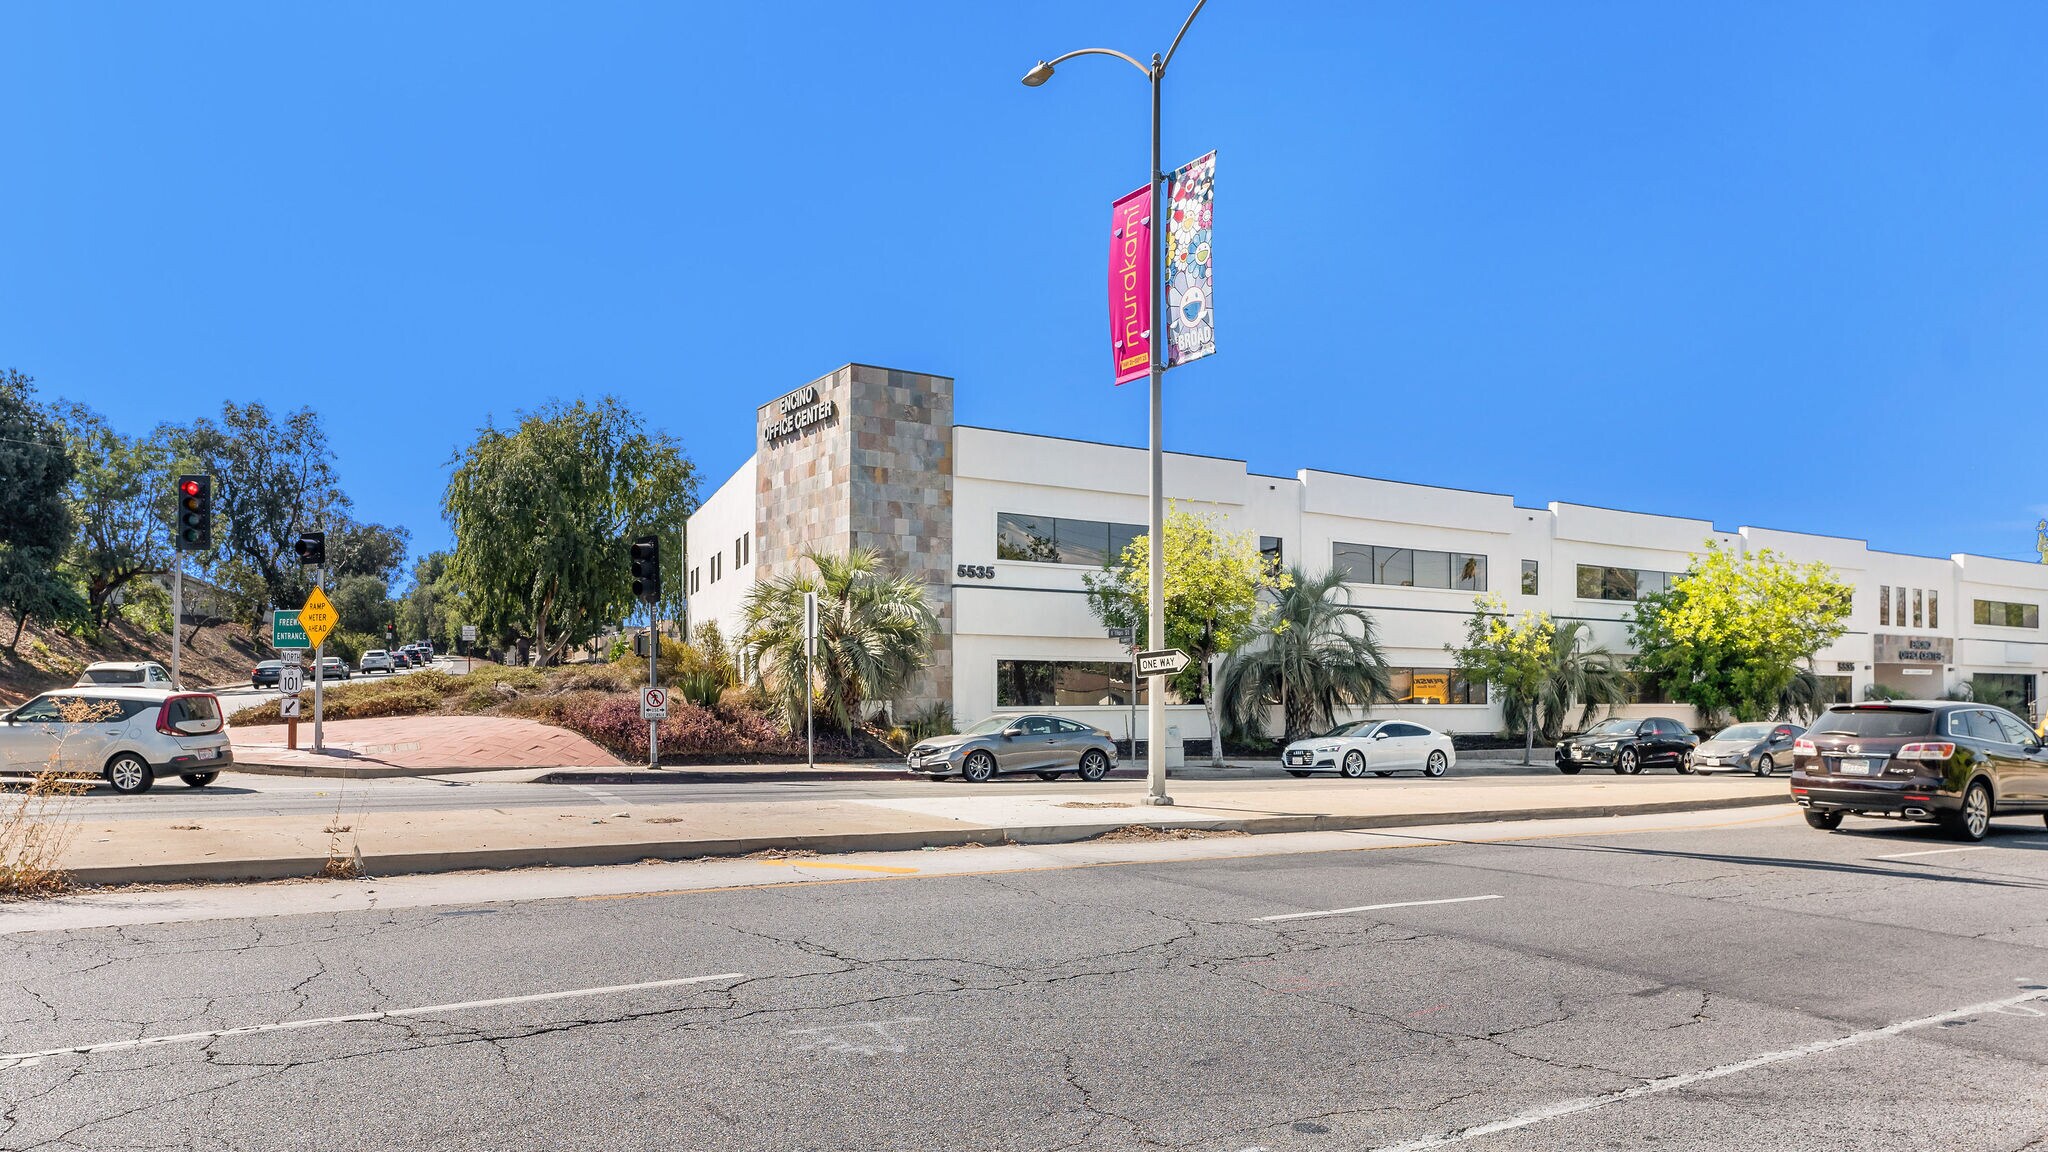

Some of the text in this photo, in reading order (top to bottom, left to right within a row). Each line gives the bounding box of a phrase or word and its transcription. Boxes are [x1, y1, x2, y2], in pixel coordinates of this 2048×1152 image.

[1120, 204, 1140, 348] murakami
[1178, 326, 1211, 352] BROAD
[780, 386, 813, 414] ENCINO
[763, 400, 832, 441] OFFICE CENTER
[957, 564, 995, 579] 5535
[310, 602, 326, 610] RAMP
[308, 613, 327, 621] METER
[308, 624, 327, 632] AHEAD
[276, 632, 306, 640] ENTRANCE
[282, 652, 300, 662] NORTH
[1142, 657, 1175, 669] ONE WAY
[284, 676, 298, 690] 101
